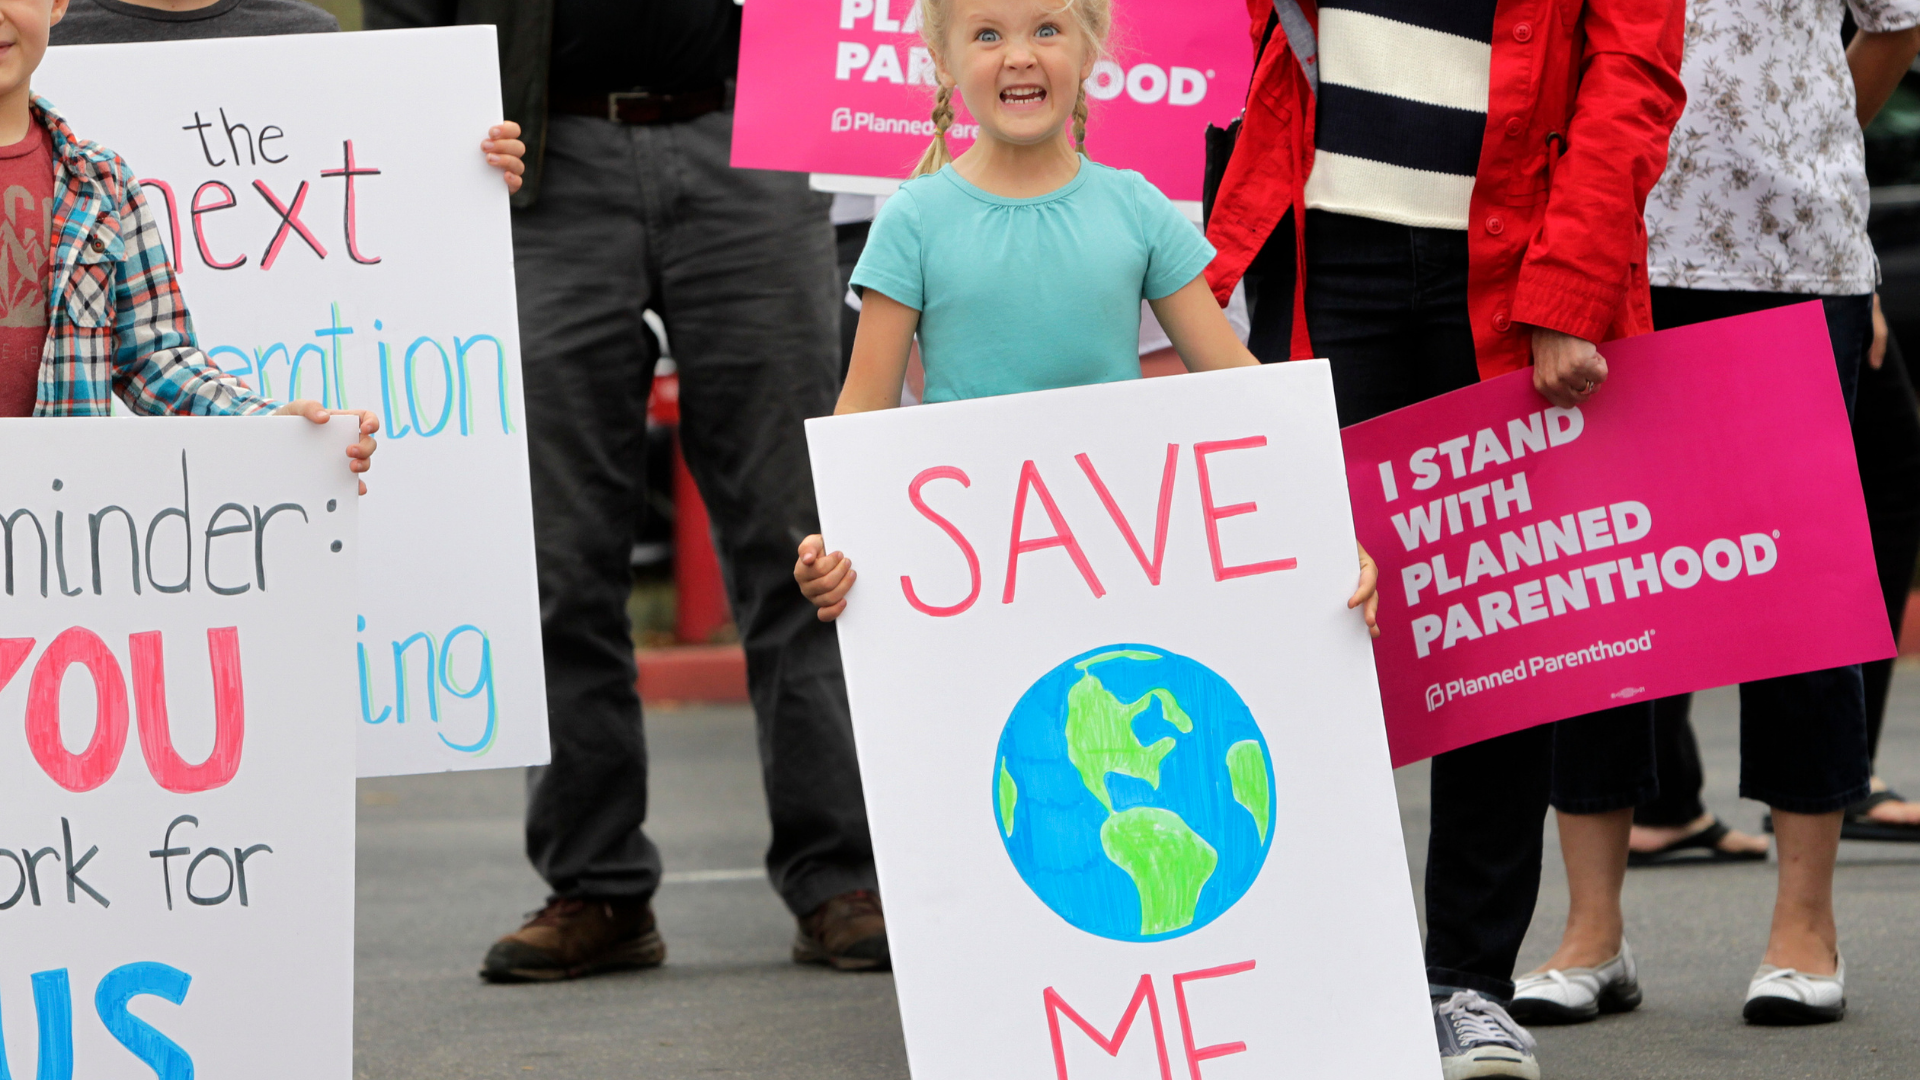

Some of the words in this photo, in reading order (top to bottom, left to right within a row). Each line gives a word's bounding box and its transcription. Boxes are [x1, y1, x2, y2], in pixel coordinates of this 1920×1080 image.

[182, 107, 289, 167] the
[853, 111, 935, 136] Planned
[138, 138, 381, 274] next
[1378, 460, 1399, 503] I
[1408, 404, 1585, 491] STAND
[900, 434, 1298, 618] SAVE
[1390, 471, 1533, 552] WITH
[1401, 500, 1653, 607] PLANNED
[0, 625, 245, 794] OU
[1446, 660, 1528, 702] Planned
[149, 814, 274, 911] for
